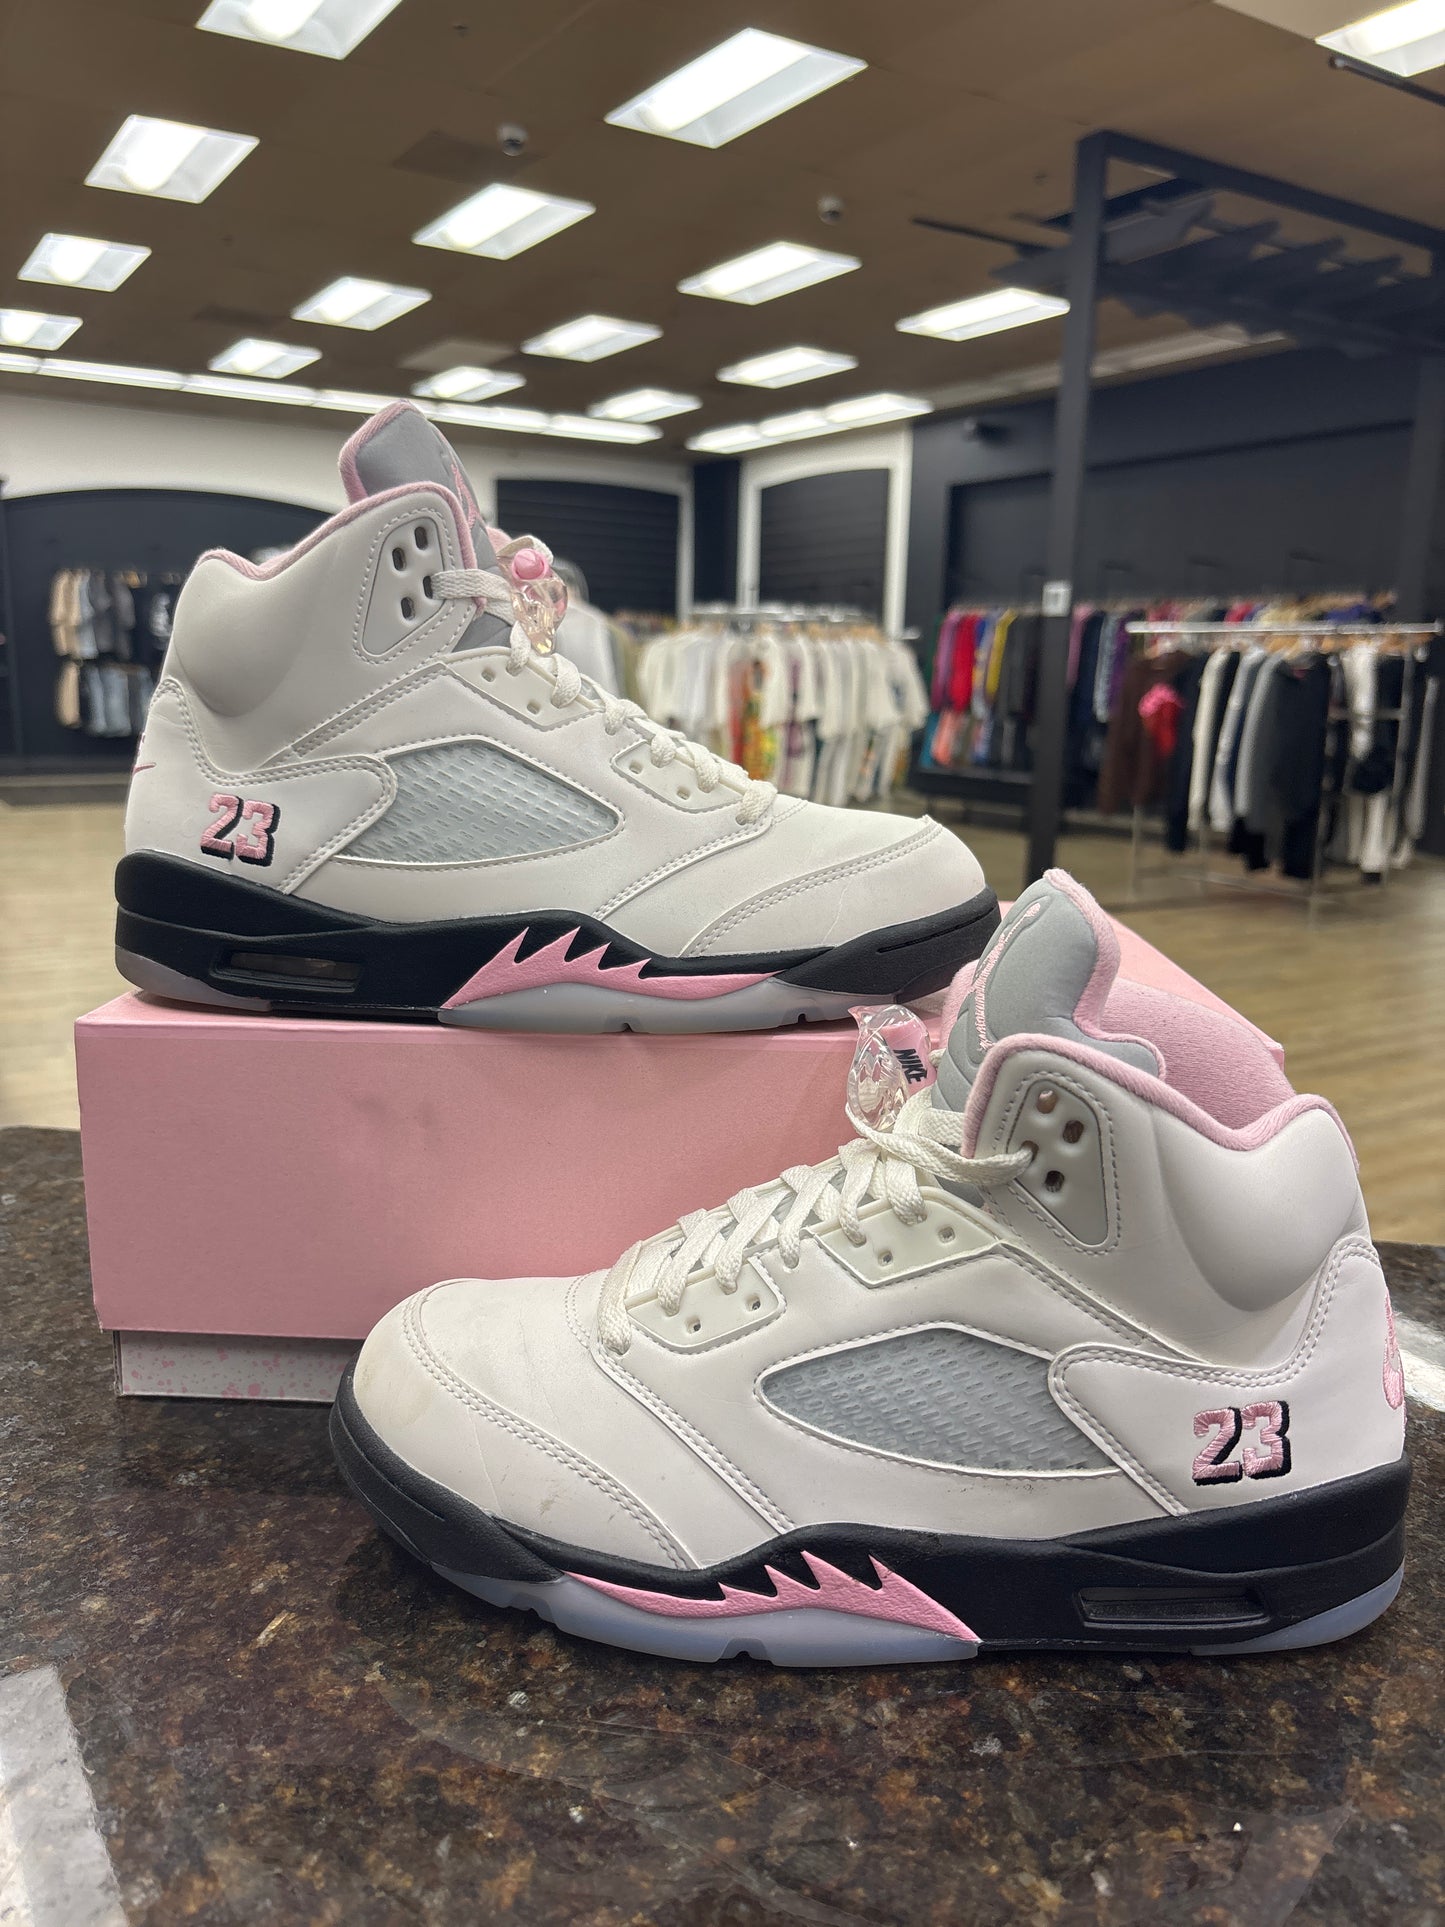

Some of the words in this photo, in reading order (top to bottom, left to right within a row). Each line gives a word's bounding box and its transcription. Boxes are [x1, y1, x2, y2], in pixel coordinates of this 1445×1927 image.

[200, 792, 281, 867] 23
[892, 1048, 928, 1085] NIKE
[1192, 1400, 1292, 1486] 23
